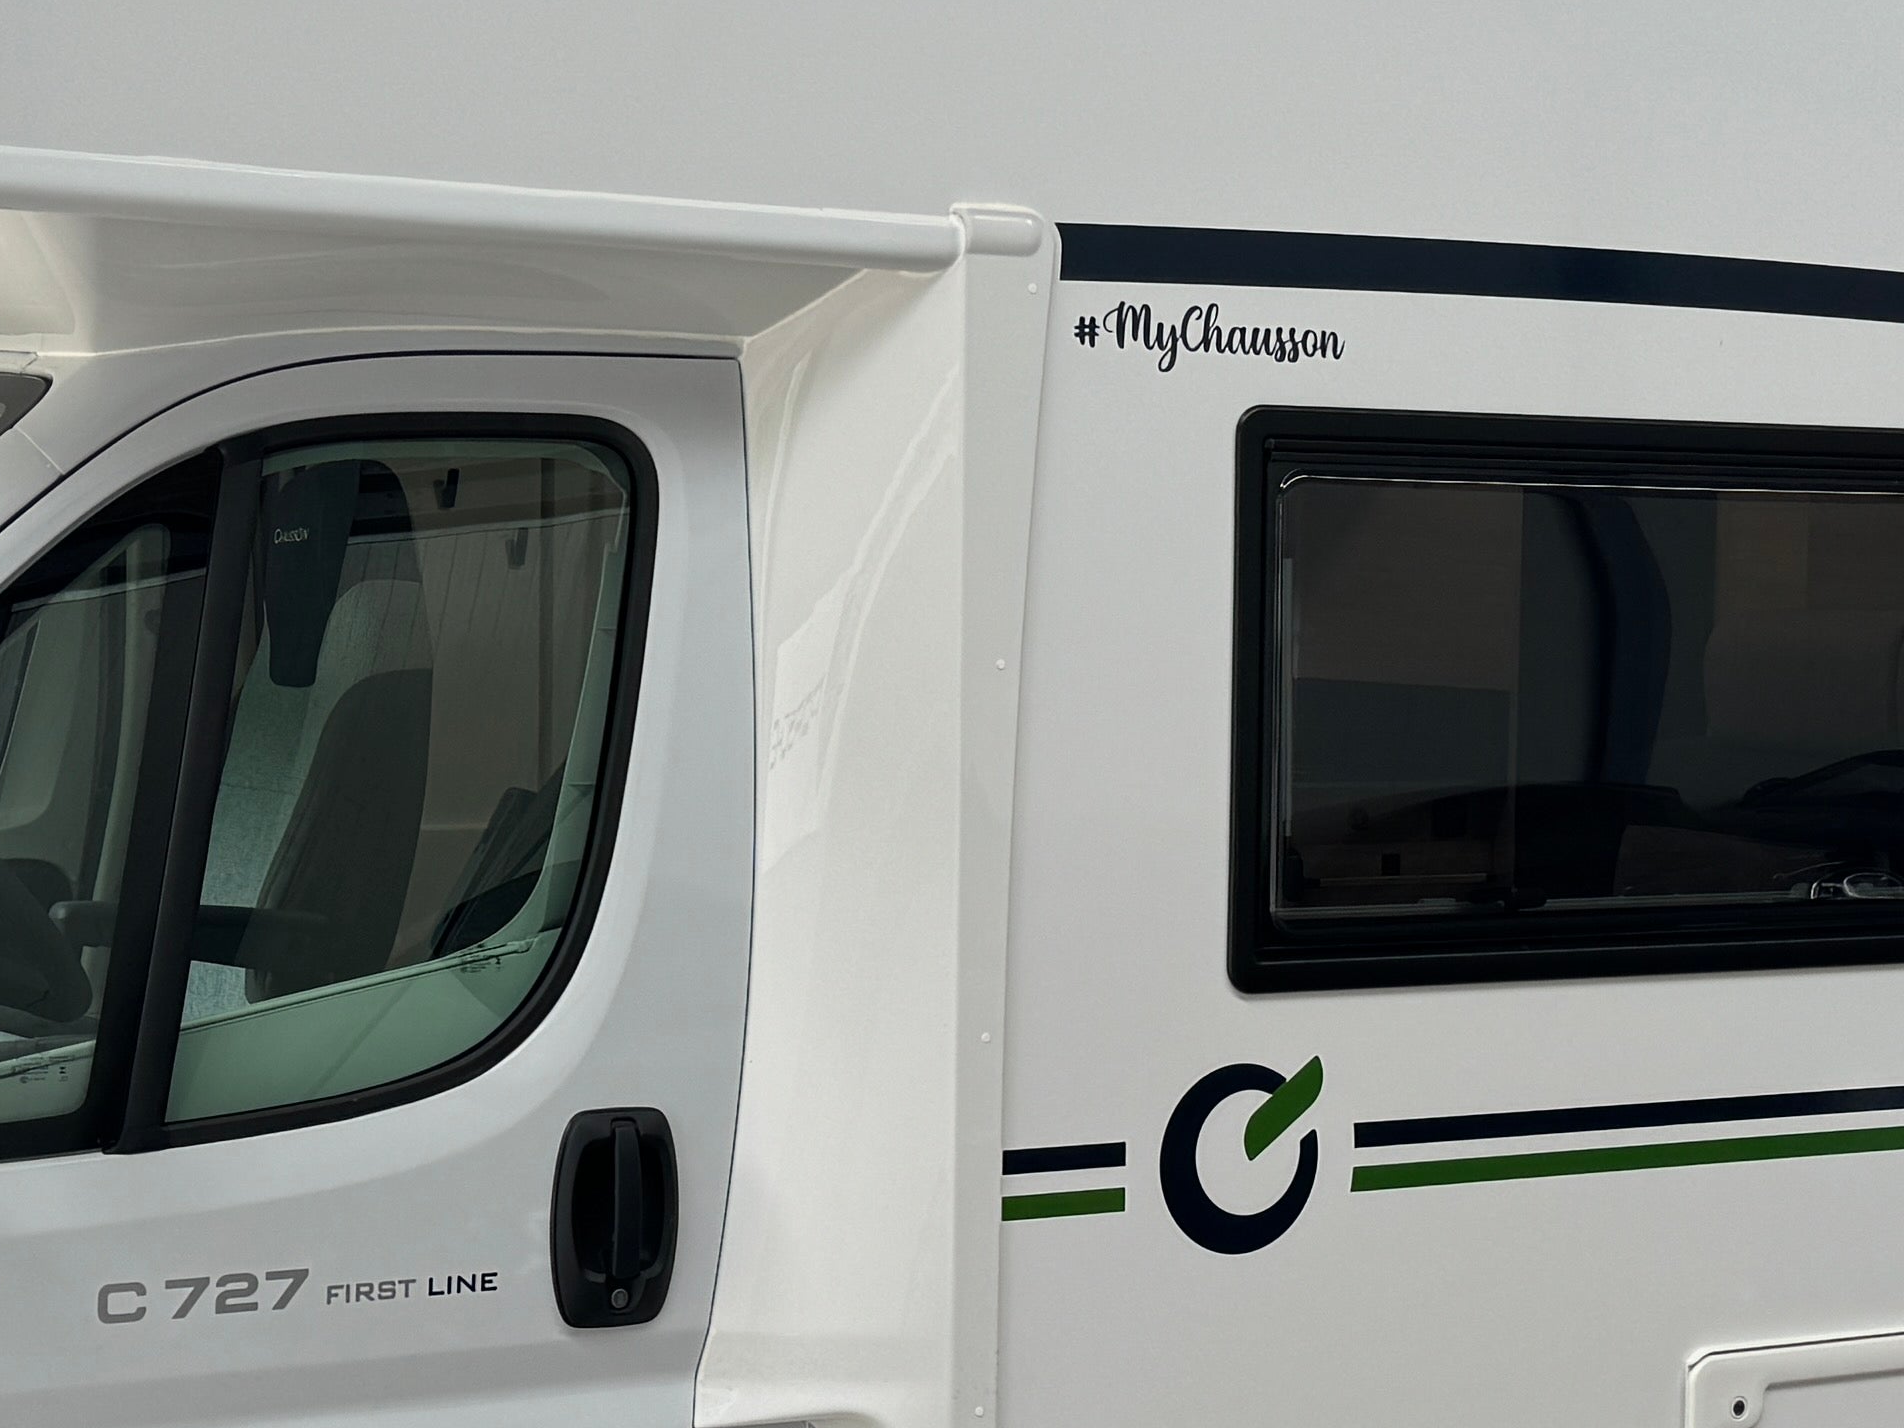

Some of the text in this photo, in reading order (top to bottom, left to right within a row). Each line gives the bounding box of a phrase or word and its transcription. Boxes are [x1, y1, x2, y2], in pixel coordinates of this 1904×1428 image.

[1074, 301, 1345, 373] #MyChausson
[98, 1268, 498, 1324] C 727 FIRST LINE
